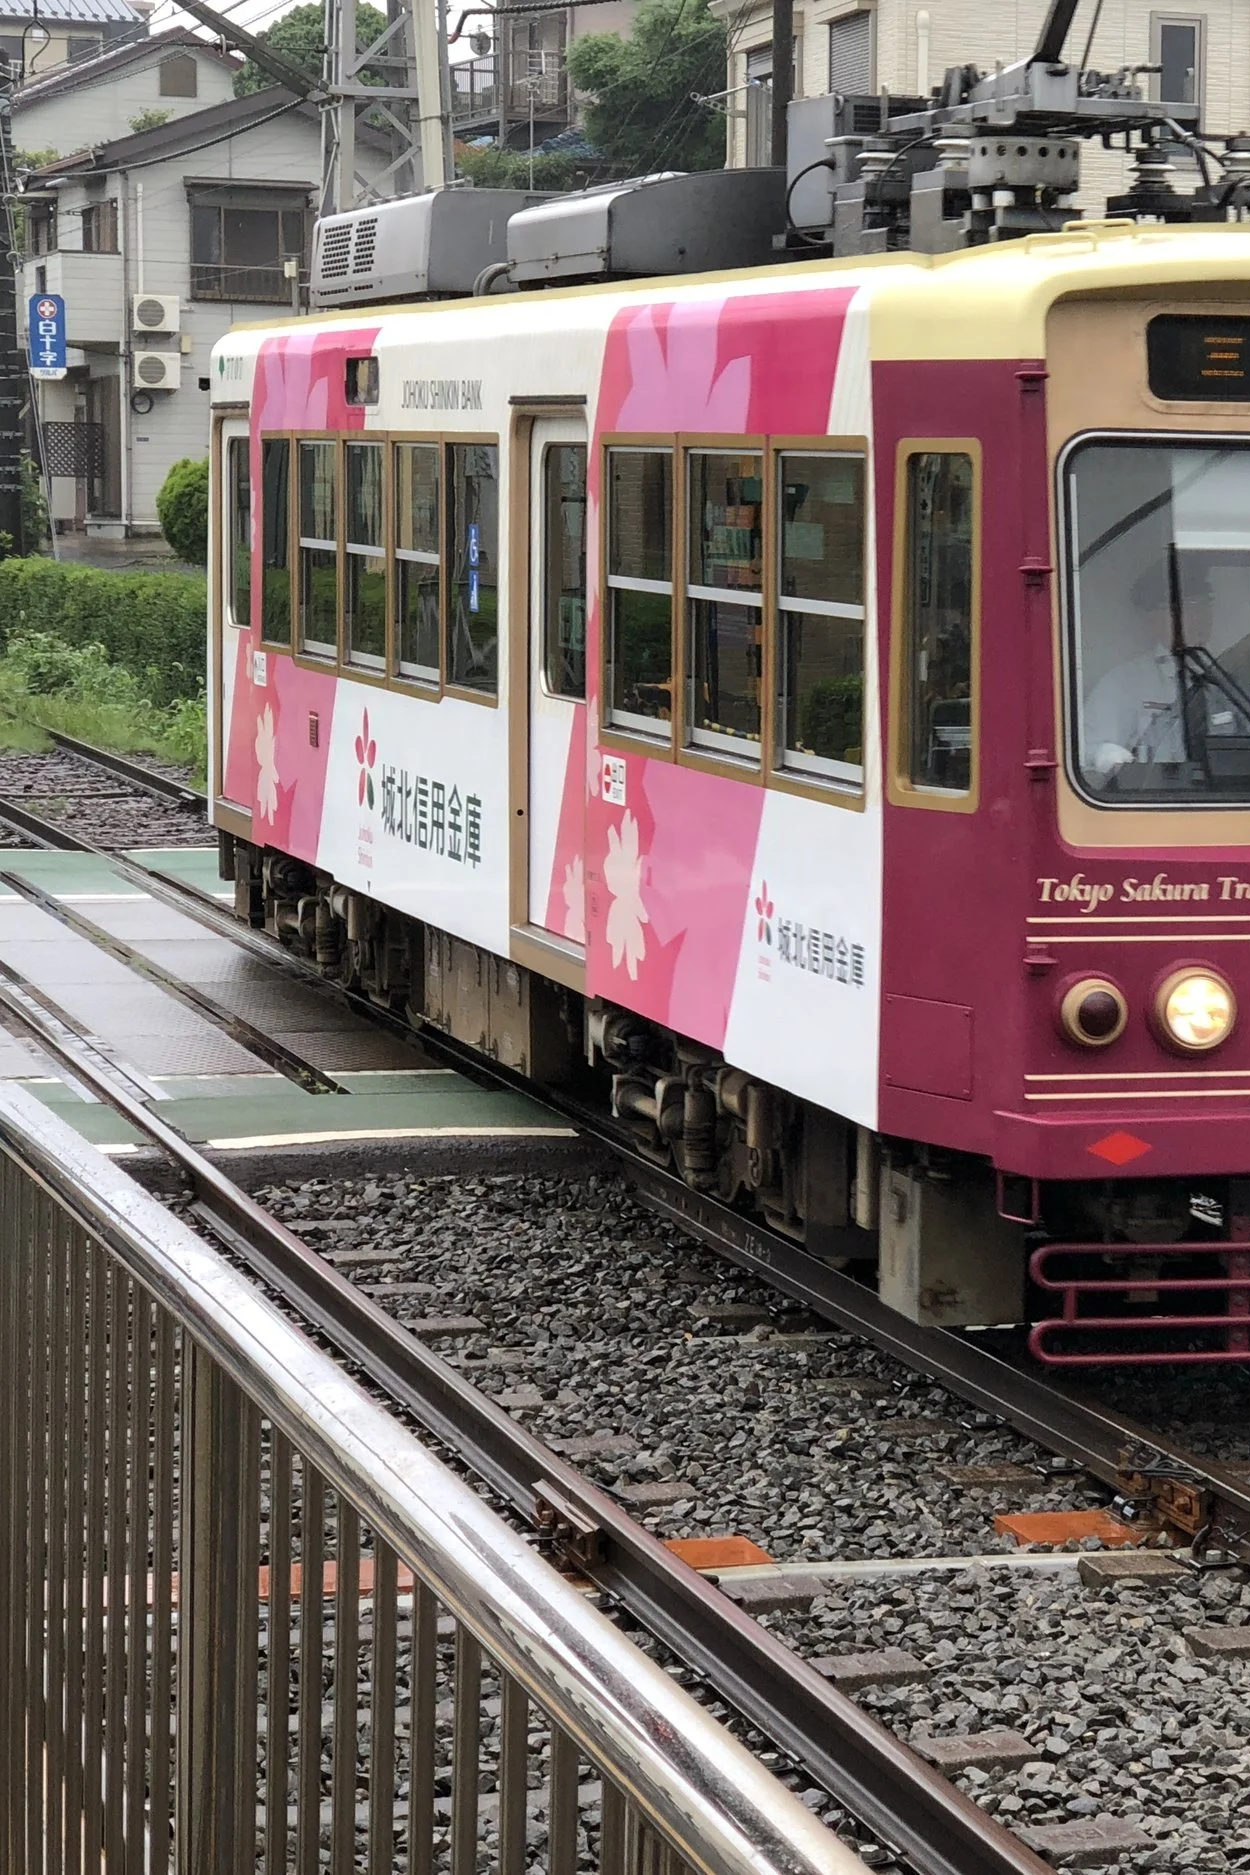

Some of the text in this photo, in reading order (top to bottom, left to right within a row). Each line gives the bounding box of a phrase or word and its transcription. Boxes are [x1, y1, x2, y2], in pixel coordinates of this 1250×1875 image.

[38, 319, 57, 366] 白十字
[402, 380, 428, 409] JOHOKU
[462, 380, 482, 410] BANK
[381, 763, 482, 869] 城北信用金庫
[1037, 873, 1114, 913] Tokyo
[1120, 873, 1209, 902] Sakura
[778, 917, 865, 989] 城北信用金庫
